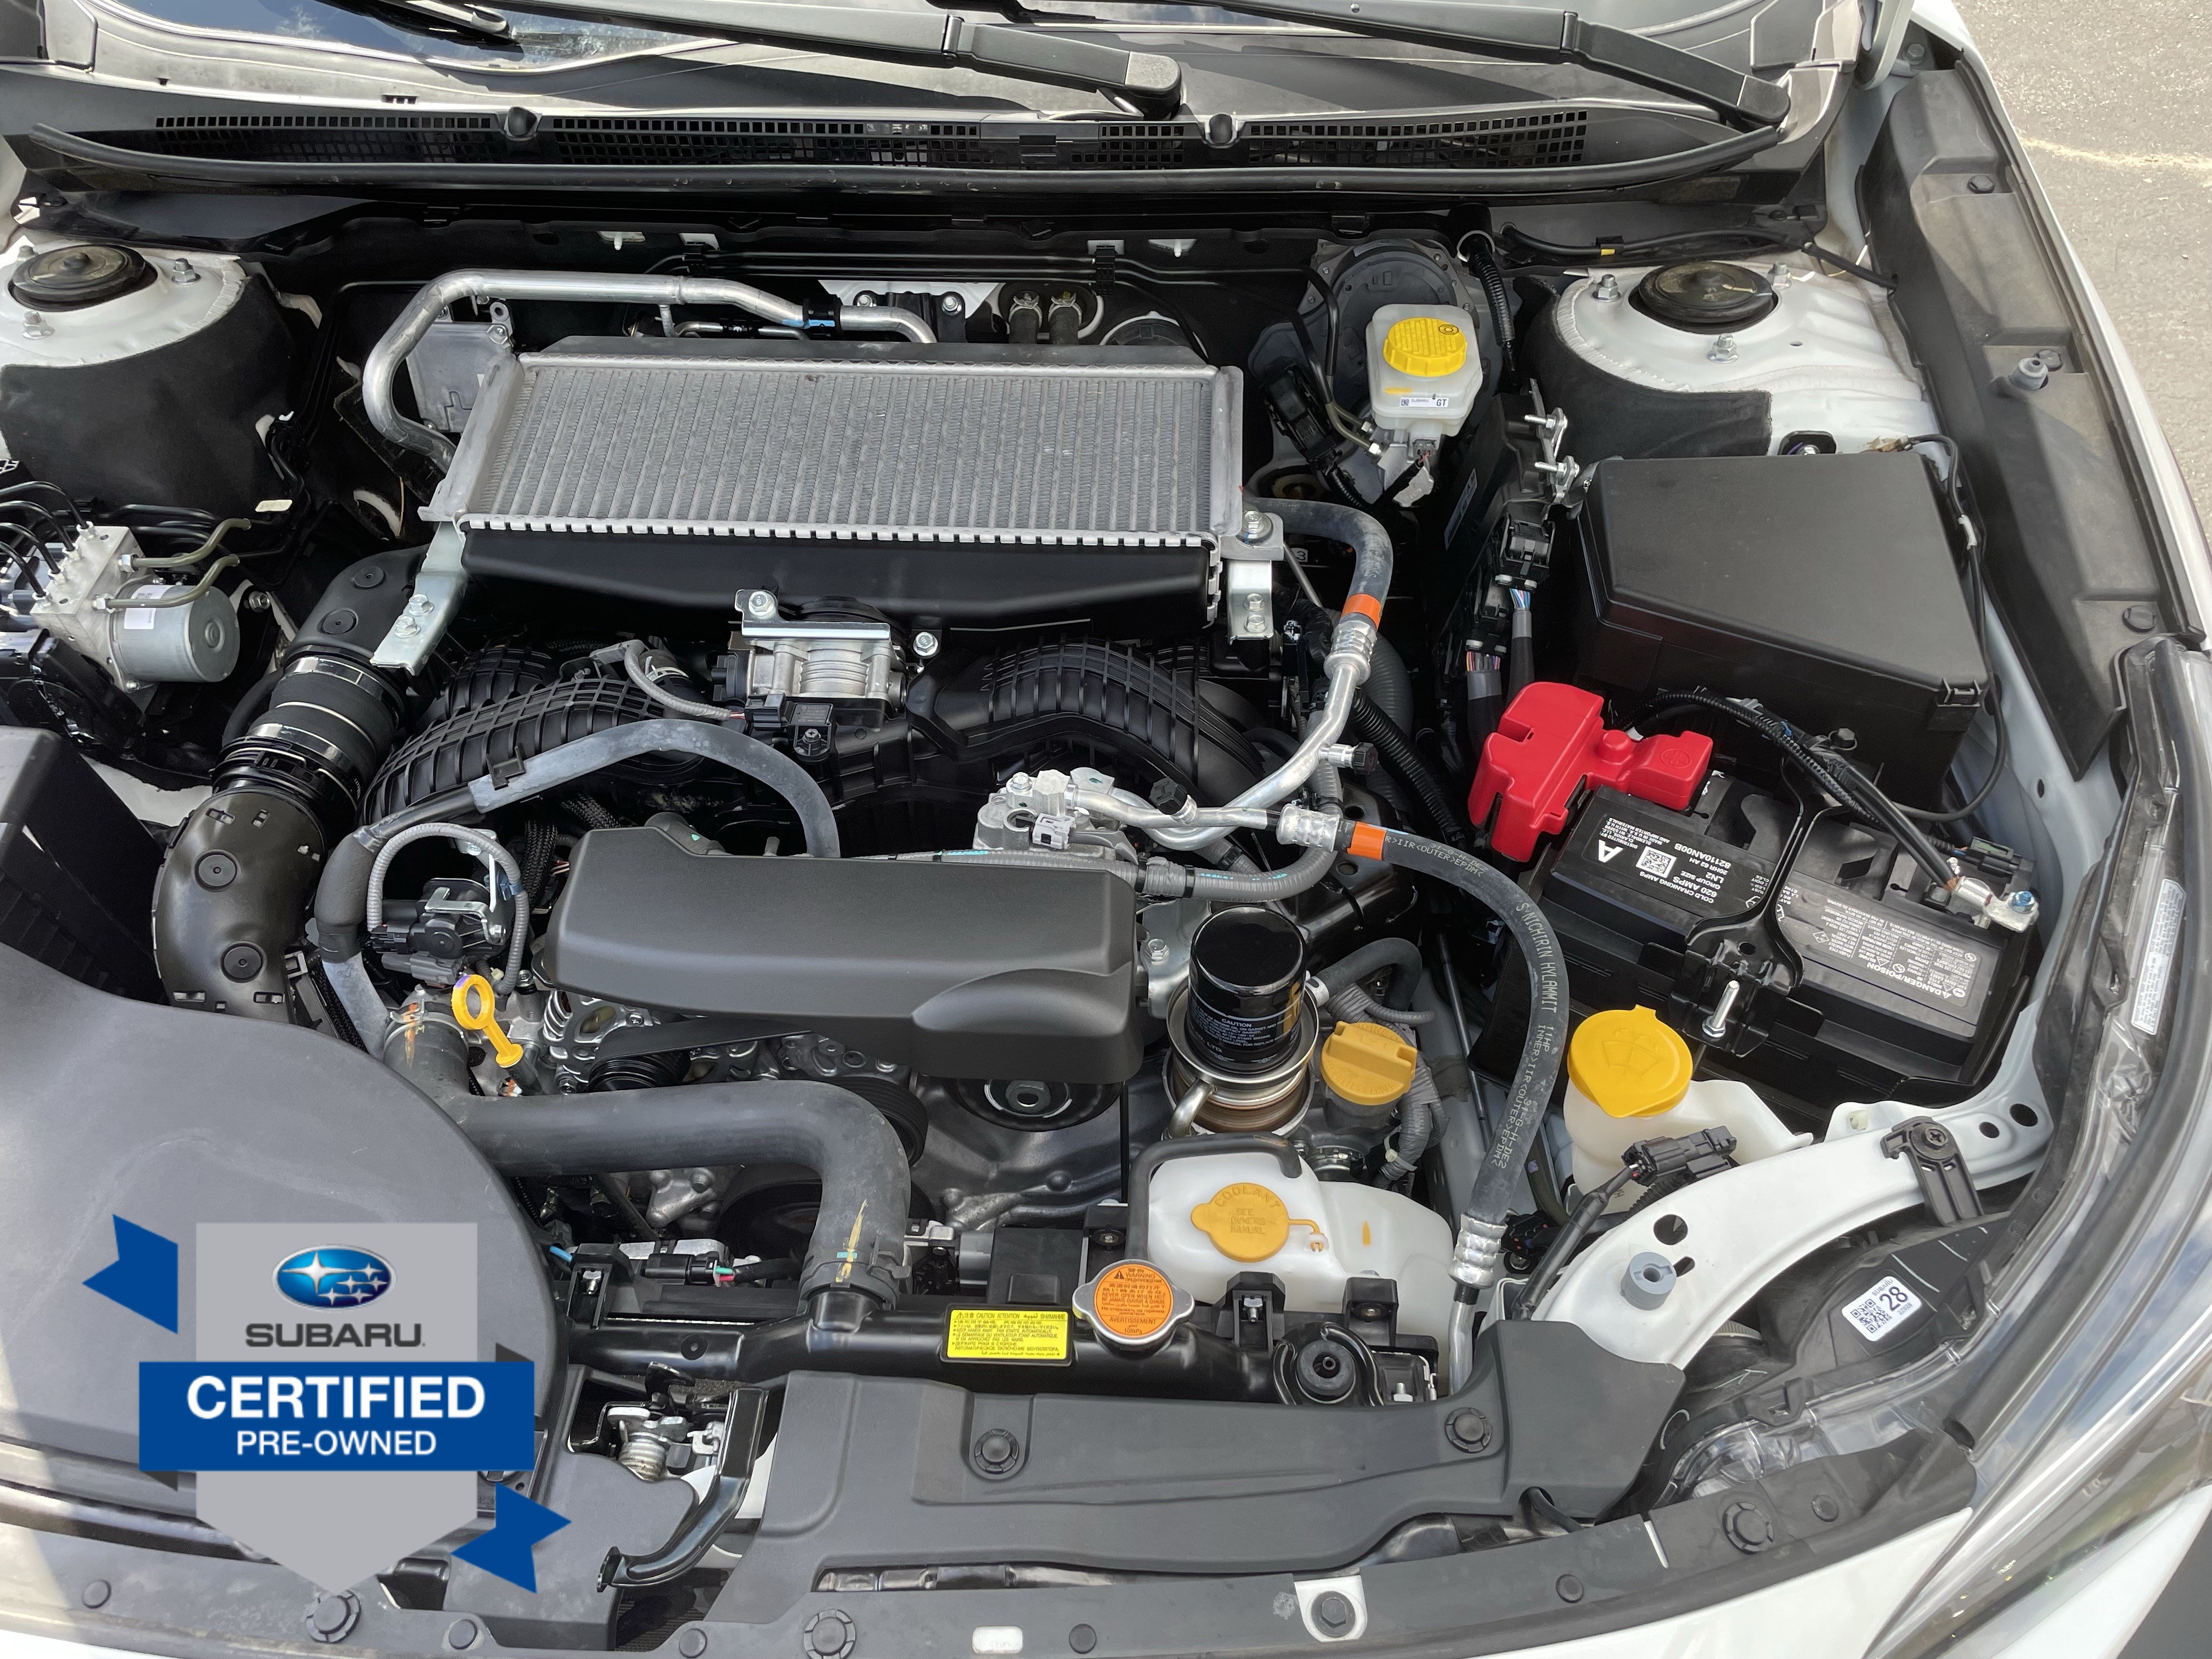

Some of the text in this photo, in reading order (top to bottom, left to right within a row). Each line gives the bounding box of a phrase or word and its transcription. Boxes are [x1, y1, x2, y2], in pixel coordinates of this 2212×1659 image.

[1598, 839, 1624, 863] A
[1607, 834, 1638, 849] DISTRIBUTED
[1674, 843, 1731, 869] 82110AN00B
[1689, 857, 1701, 865] AH
[1680, 870, 1721, 890] GROUP SIZE
[1705, 872, 1724, 884] LN2
[1709, 865, 1728, 876] 20HR
[1639, 871, 1714, 904] COLD CRANKING AMPS
[1672, 876, 1718, 898] 620 AMPS
[1540, 962, 1558, 1013] HYLAMMIT
[1867, 962, 1942, 996] DANGER/POISON
[1221, 1018, 1252, 1028] CAUTION
[1215, 1185, 1280, 1207] COOLANT
[1879, 1286, 1908, 1312] 28
